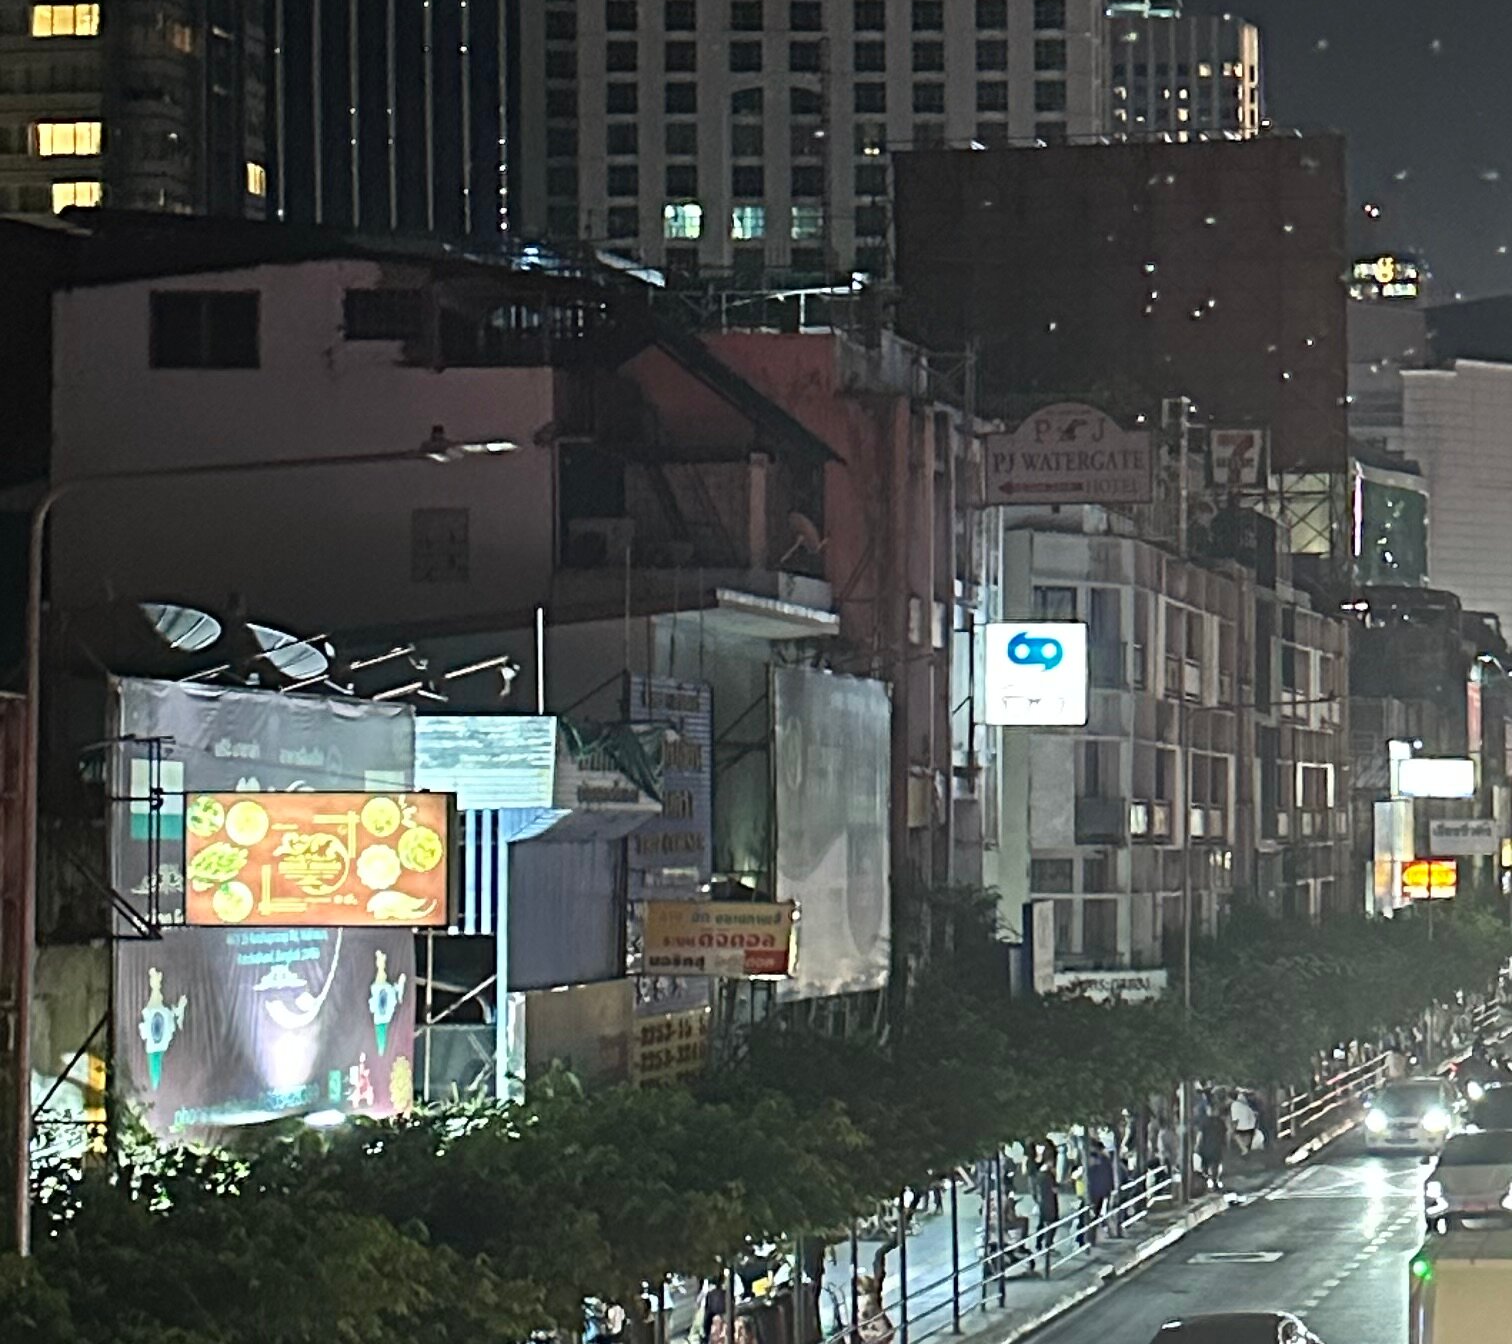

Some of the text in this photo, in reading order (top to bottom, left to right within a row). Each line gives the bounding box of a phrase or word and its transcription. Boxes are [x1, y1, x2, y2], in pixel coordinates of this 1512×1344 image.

[993, 450, 1145, 473] PJ WATERGATE
[1086, 479, 1138, 494] HOTEL
